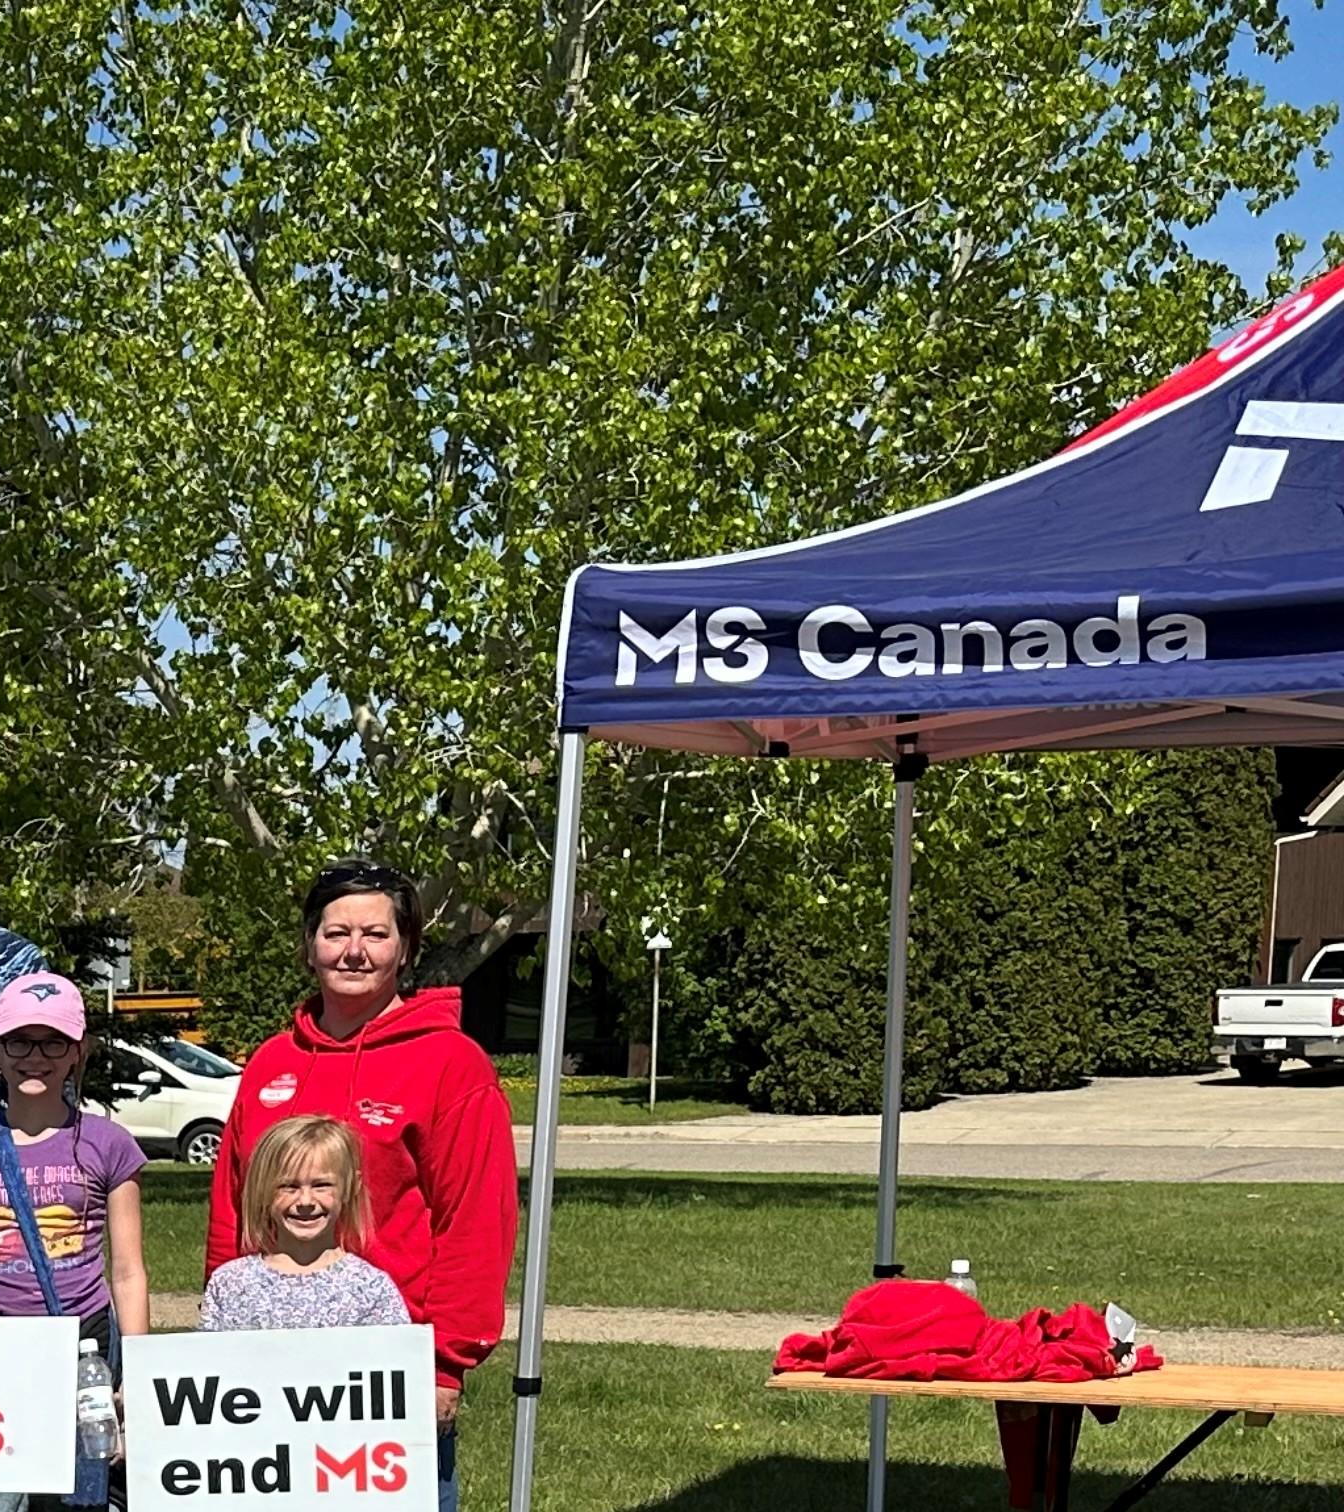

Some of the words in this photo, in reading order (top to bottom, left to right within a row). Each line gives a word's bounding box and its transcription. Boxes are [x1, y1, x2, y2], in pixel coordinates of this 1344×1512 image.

[616, 606, 768, 686] MS
[799, 595, 1208, 681] Canada
[153, 1374, 261, 1427] We
[283, 1369, 407, 1423] will
[161, 1443, 291, 1496] end
[315, 1441, 409, 1494] MS
